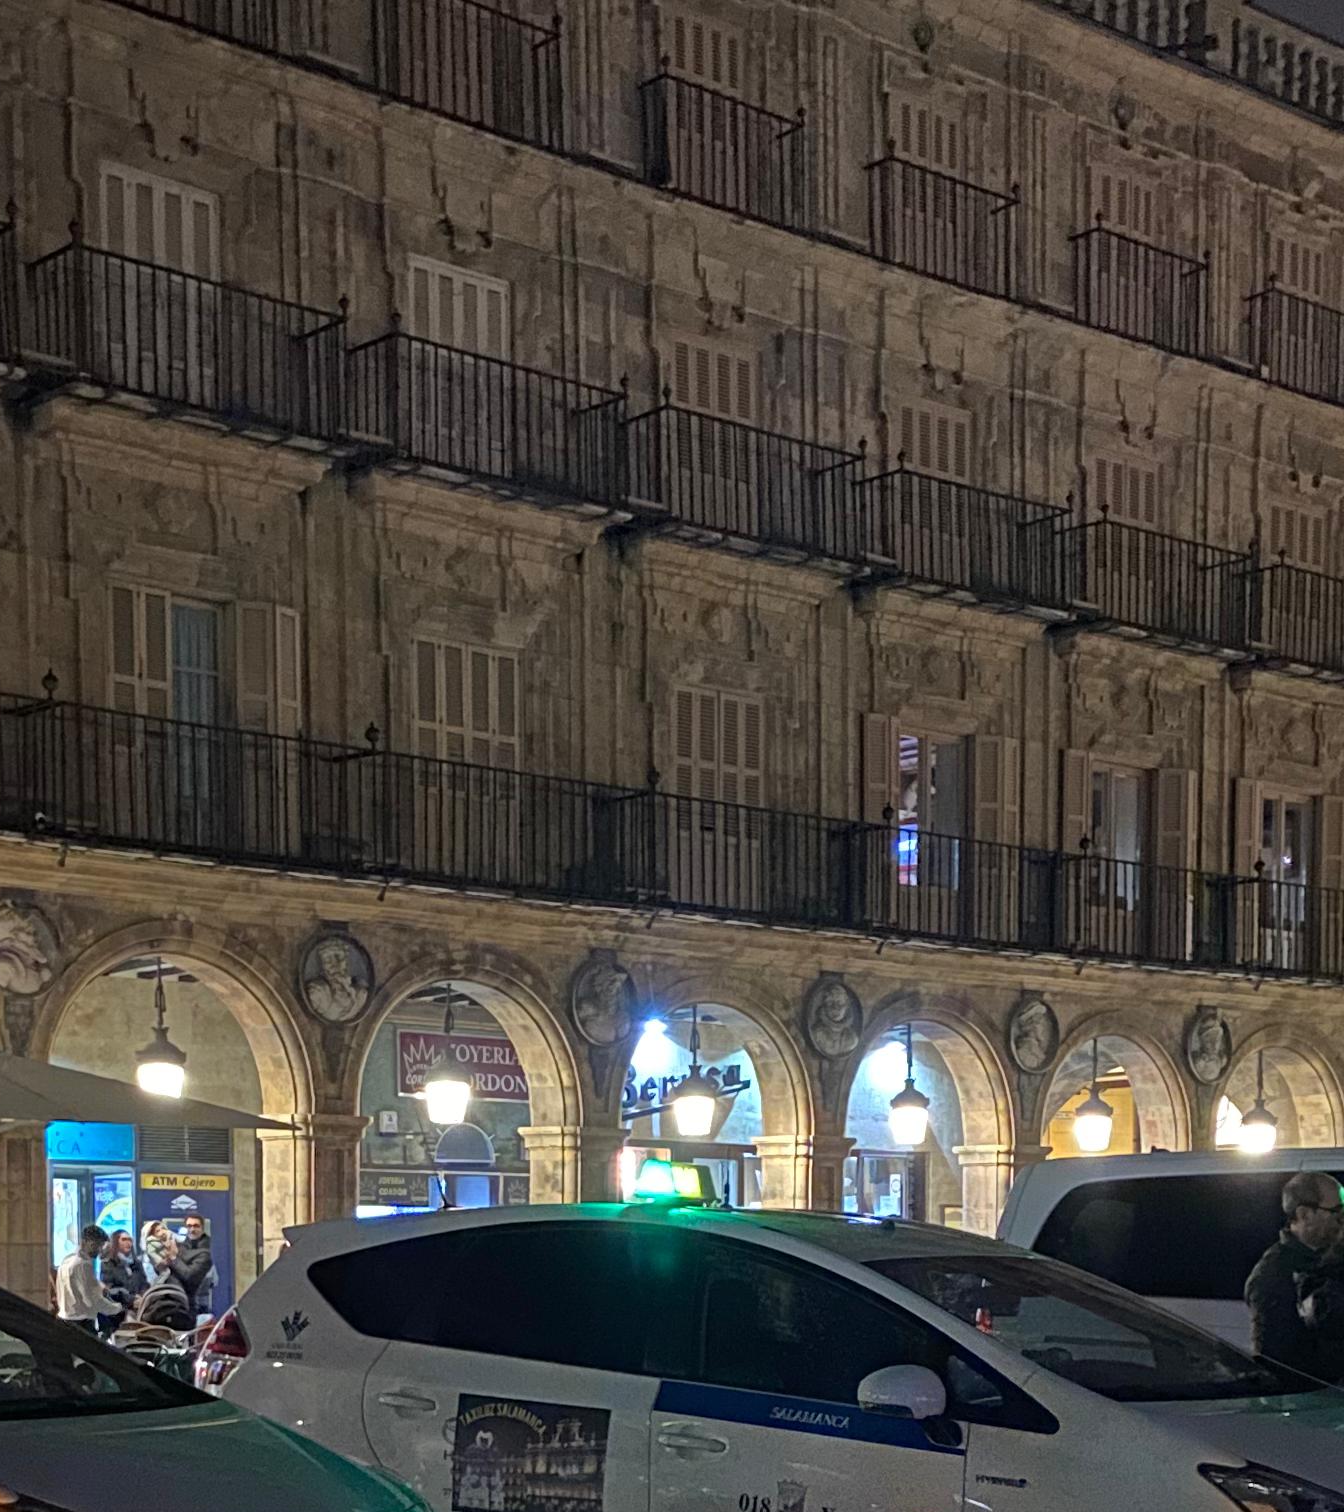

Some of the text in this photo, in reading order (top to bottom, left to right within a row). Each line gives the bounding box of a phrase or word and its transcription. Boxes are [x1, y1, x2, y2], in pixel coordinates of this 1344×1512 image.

[450, 1043, 519, 1066] OYERIA
[469, 1071, 527, 1093] RDON
[152, 1176, 216, 1189] ATM Cajero
[497, 1402, 547, 1435] SALAMANCA
[769, 1406, 850, 1429] SALAMANCA
